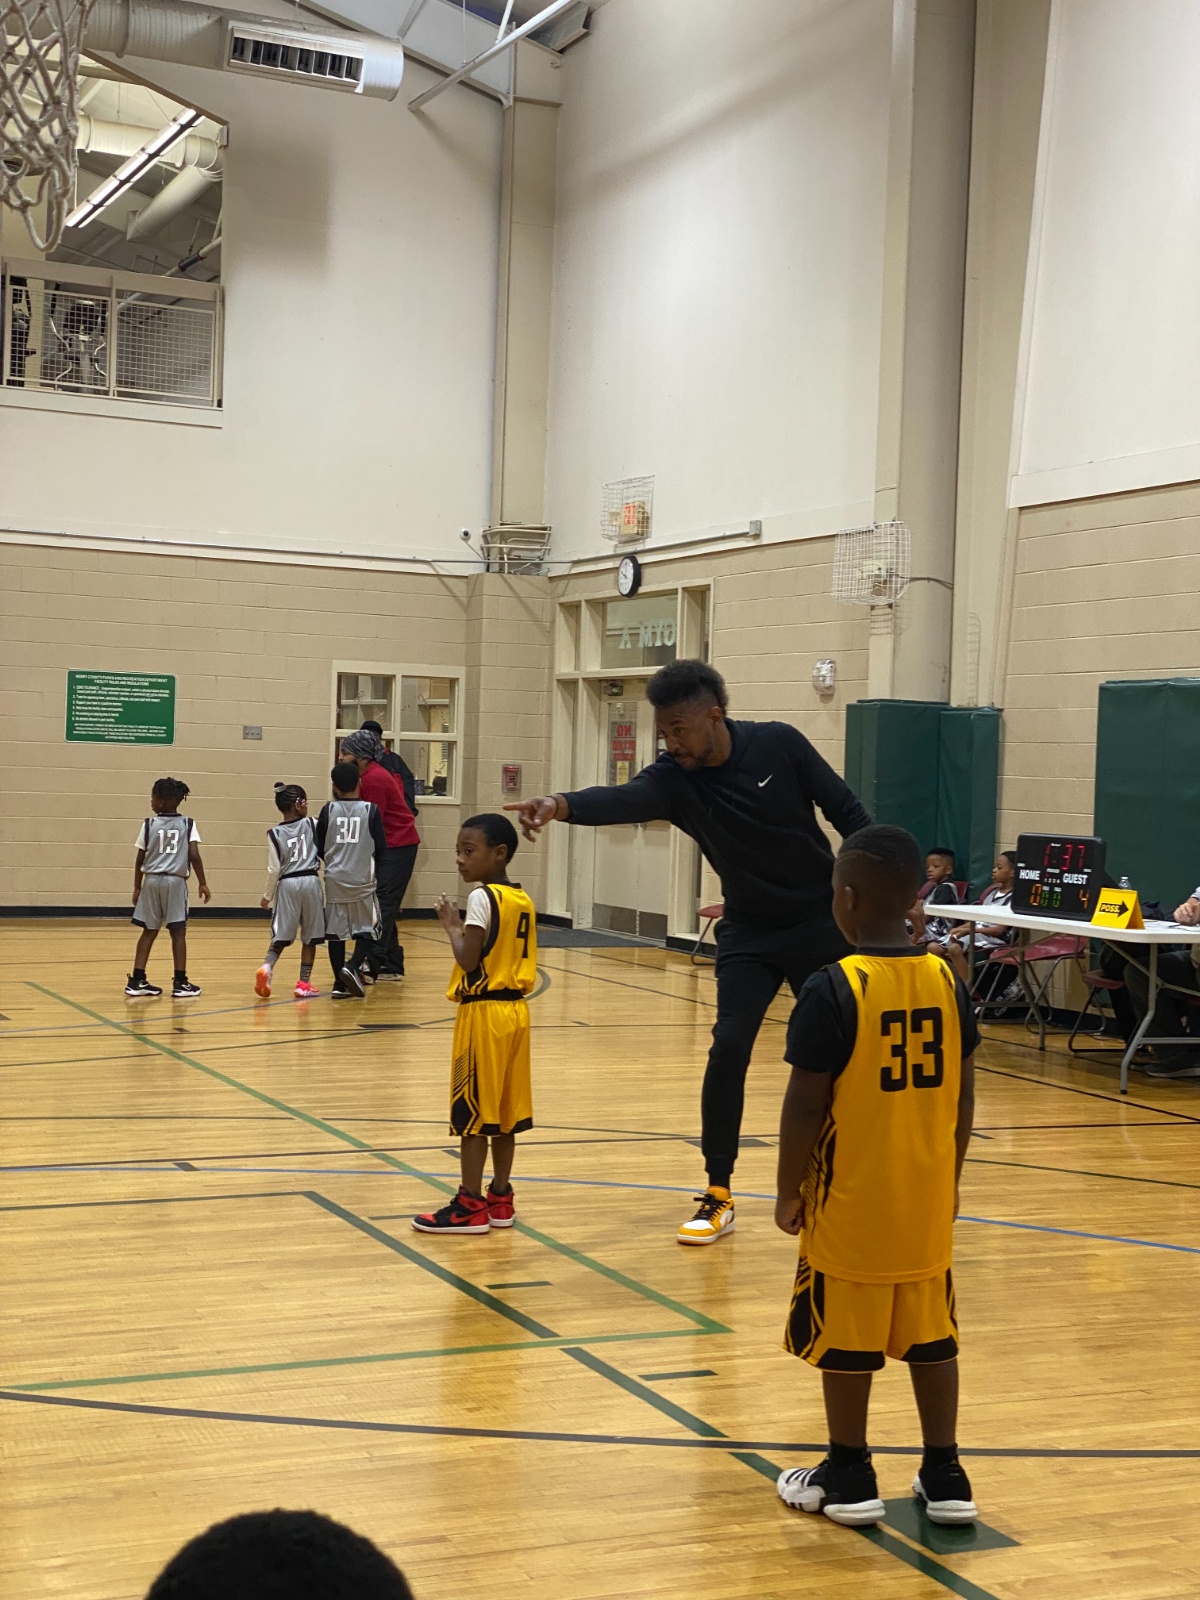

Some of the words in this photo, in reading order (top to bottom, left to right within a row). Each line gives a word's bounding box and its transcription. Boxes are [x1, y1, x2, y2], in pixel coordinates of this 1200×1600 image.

[336, 816, 361, 844] 30
[157, 829, 179, 854] 13
[286, 833, 308, 863] 31
[1019, 869, 1041, 880] HOME
[1062, 873, 1088, 884] GUEST
[1079, 889, 1090, 909] 4
[1100, 903, 1120, 913] POSS.
[880, 1006, 944, 1092] 33
